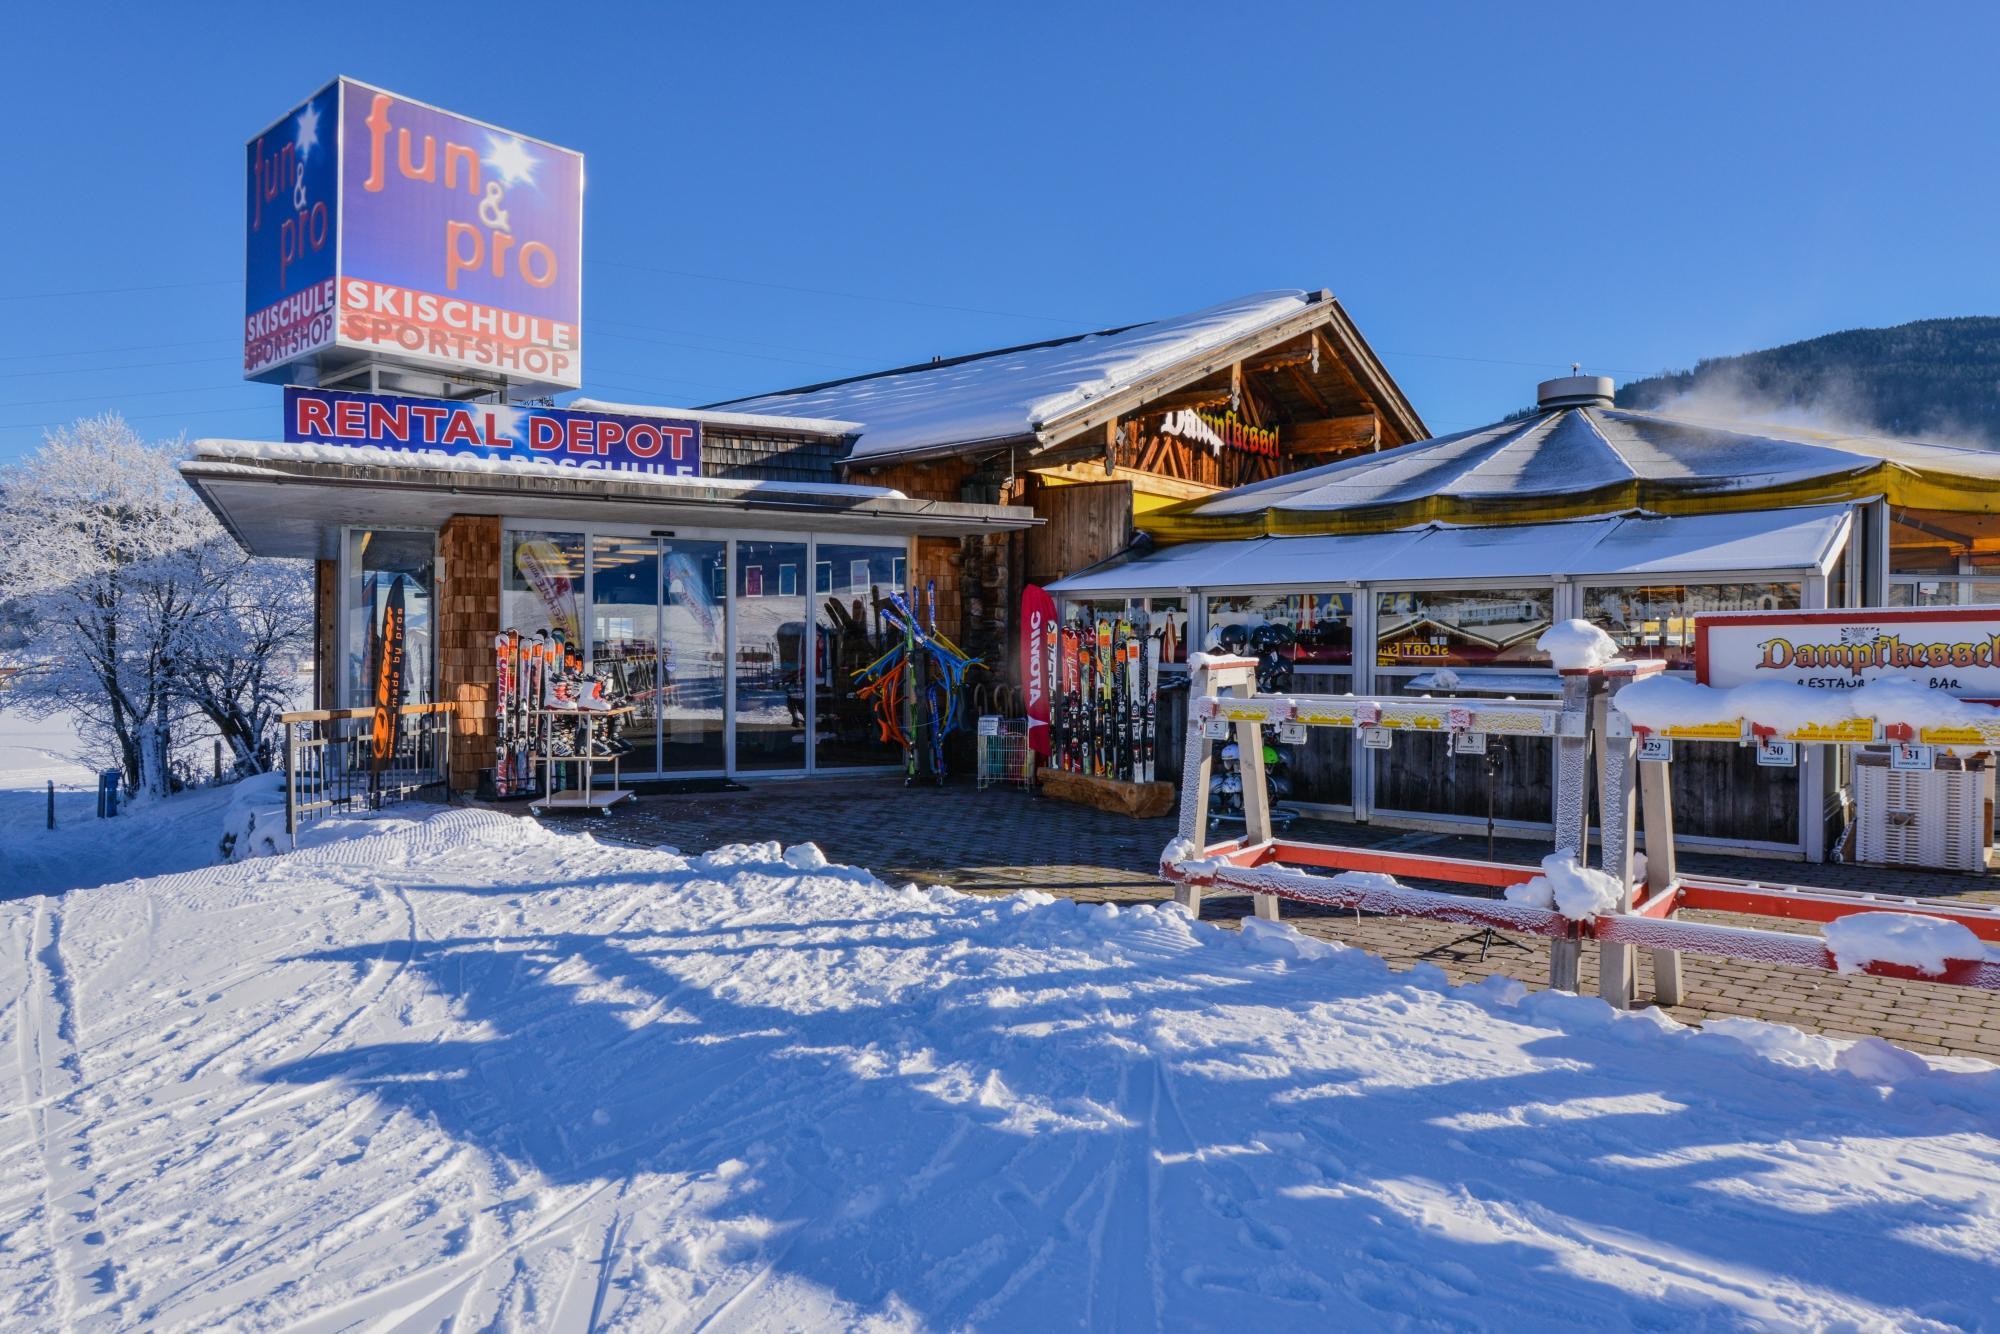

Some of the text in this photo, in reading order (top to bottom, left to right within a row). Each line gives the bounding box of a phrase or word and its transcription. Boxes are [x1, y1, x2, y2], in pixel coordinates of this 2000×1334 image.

[363, 94, 480, 196] fun
[252, 137, 295, 233] fun
[293, 164, 307, 210] &
[478, 181, 512, 233] &
[279, 200, 329, 292] pro
[445, 219, 559, 291] pro
[246, 278, 335, 342] SKISCHULE
[346, 281, 571, 351] SKISCHULE
[246, 314, 333, 371] SPORTSHOP
[345, 313, 570, 378] SPORTSHOP
[297, 398, 513, 449] RENTAL
[528, 415, 693, 461] DEPOT
[391, 607, 403, 707] made by pros
[1929, 677, 1962, 689] BAR
[1375, 731, 1380, 739] 7
[1468, 736, 1473, 744] 8
[1769, 745, 1784, 755] 30
